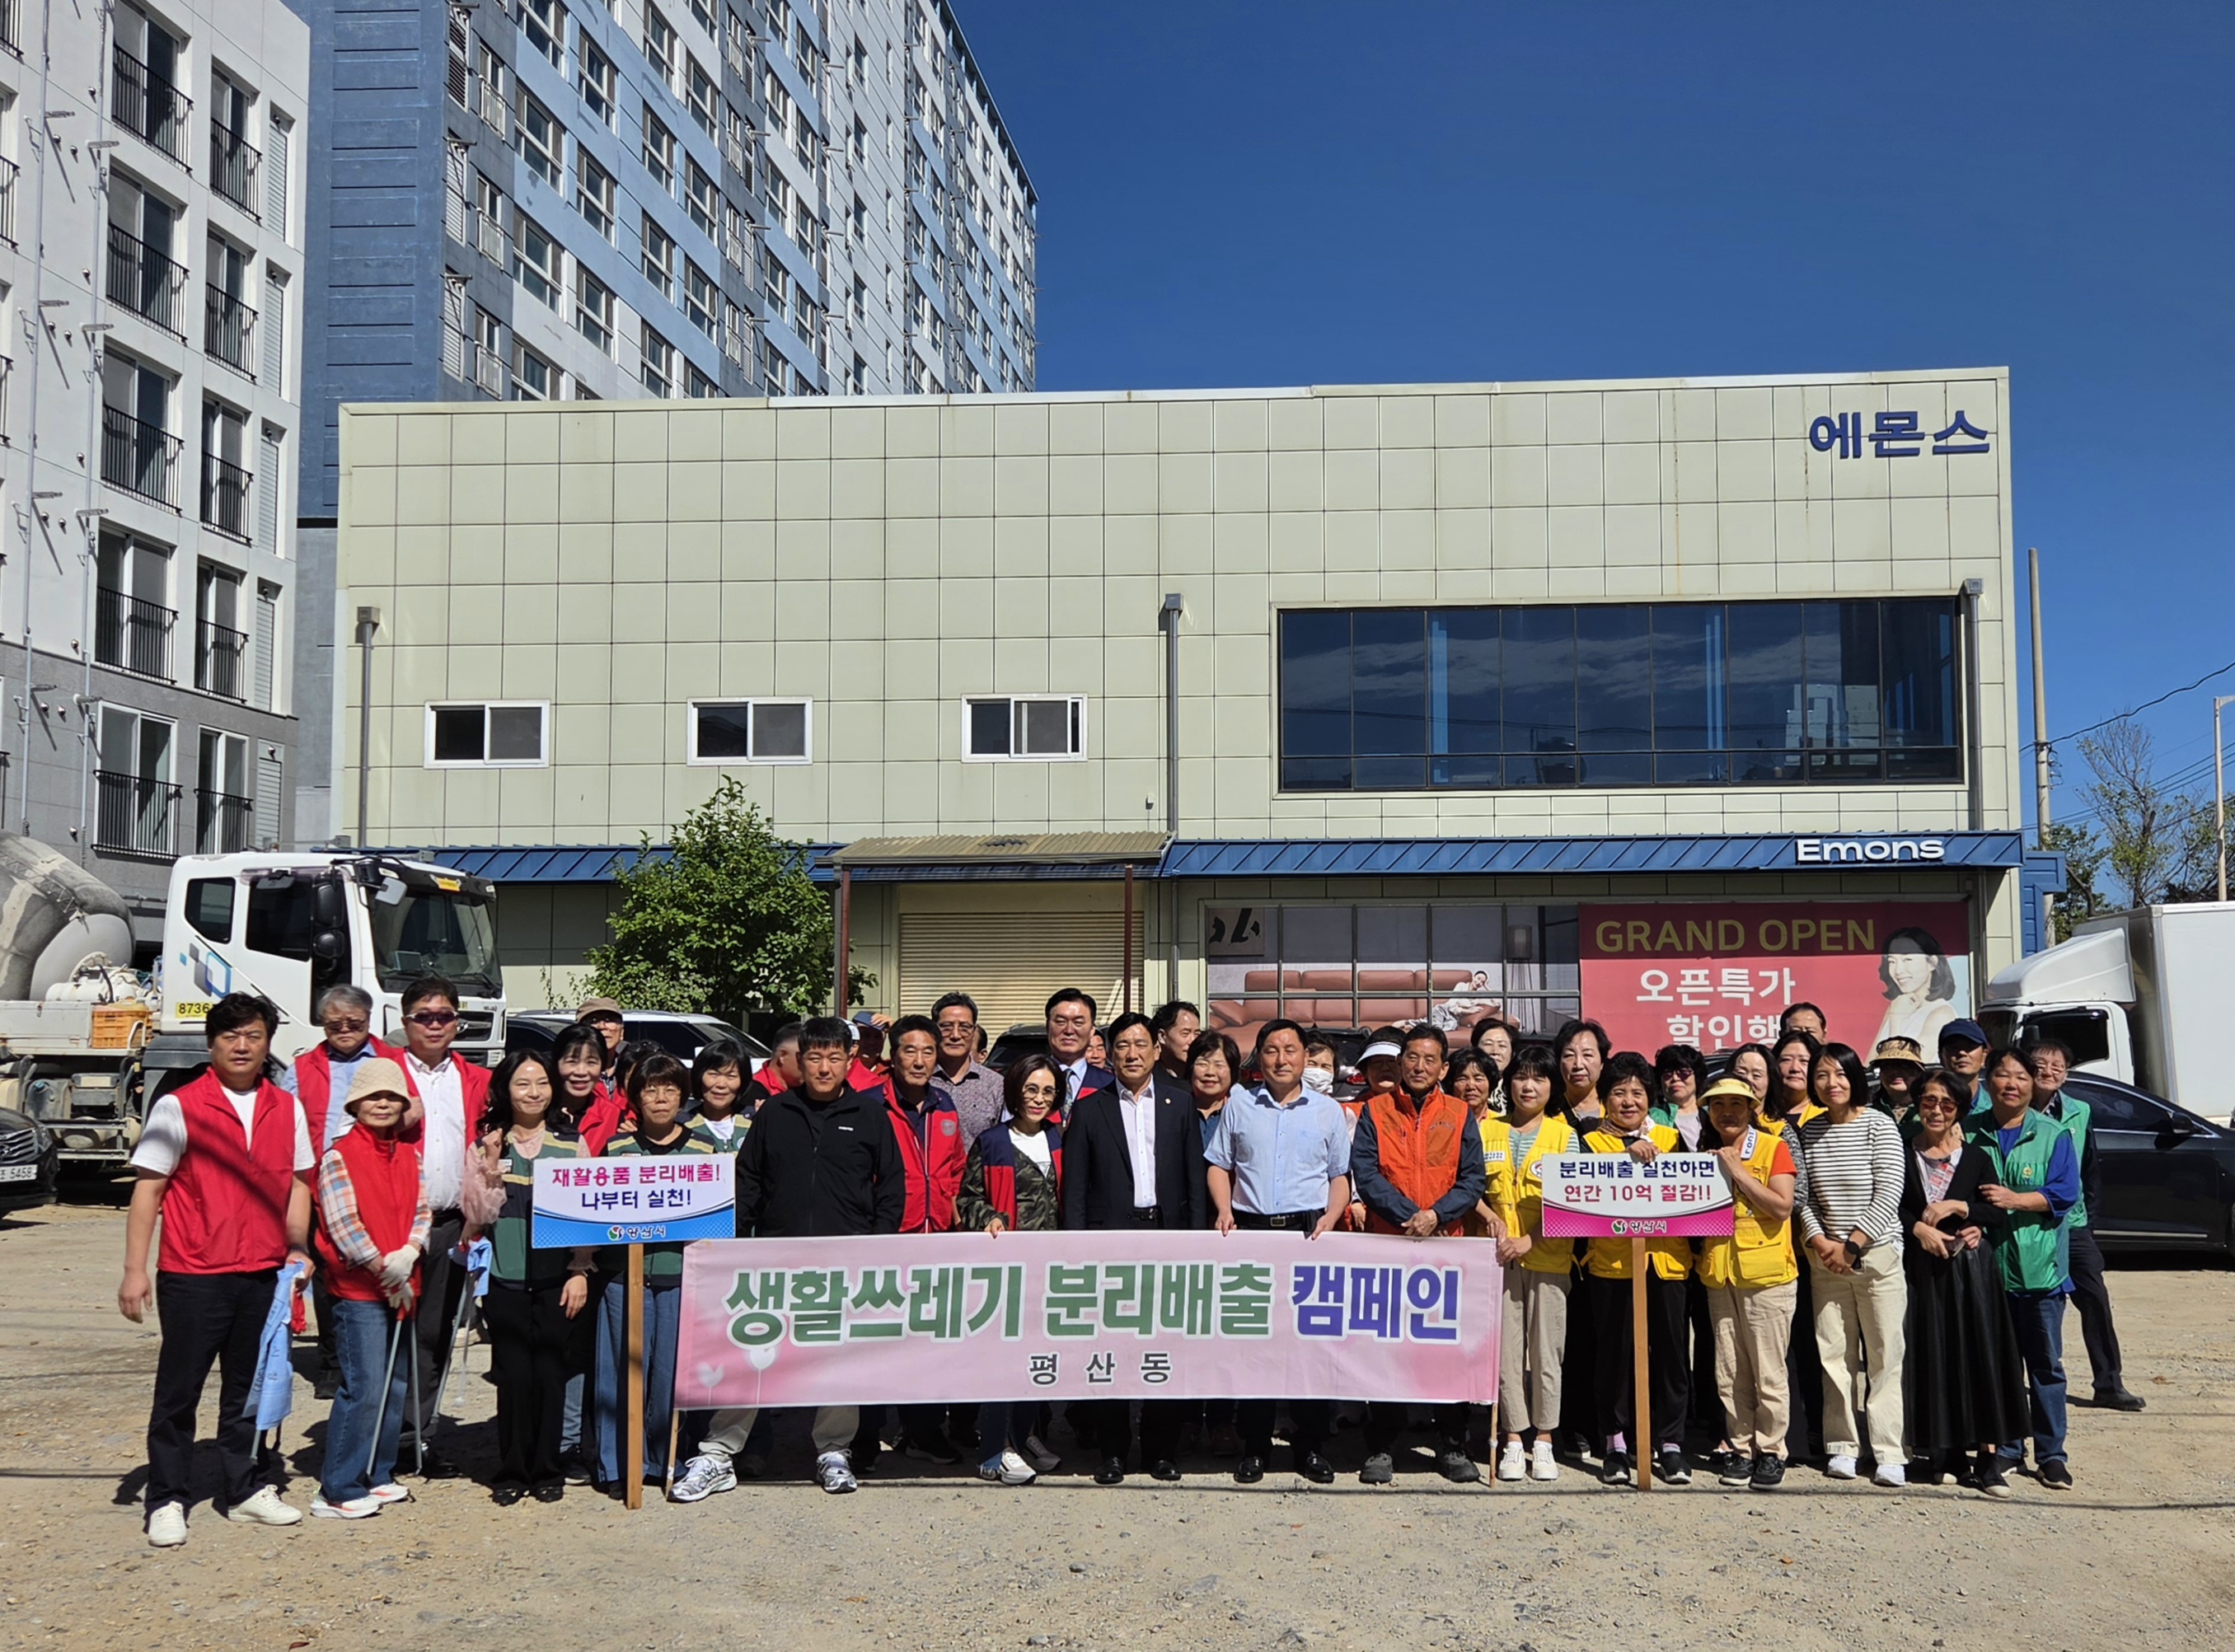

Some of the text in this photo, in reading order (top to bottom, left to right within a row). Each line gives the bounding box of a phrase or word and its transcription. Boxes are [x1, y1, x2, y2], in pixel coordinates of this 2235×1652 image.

[1809, 409, 1990, 459] 에몬스
[1797, 839, 1945, 862] Emons
[1595, 919, 1875, 952] GRAND OPEN
[1636, 967, 1796, 1006] 오픈특가
[10, 1167, 32, 1179] 5458
[552, 1163, 719, 1187] 재활용품 분리배출!
[1560, 1160, 1715, 1178] 분리배출 실천하면
[582, 1189, 691, 1210] 나부터 실천!
[1564, 1185, 1711, 1202] 연간 10억 절감!!
[627, 1225, 666, 1238] 양산시
[1630, 1221, 1666, 1233] 양산시
[725, 1264, 1459, 1345] 생활쓰레기 분리배출 캠페인
